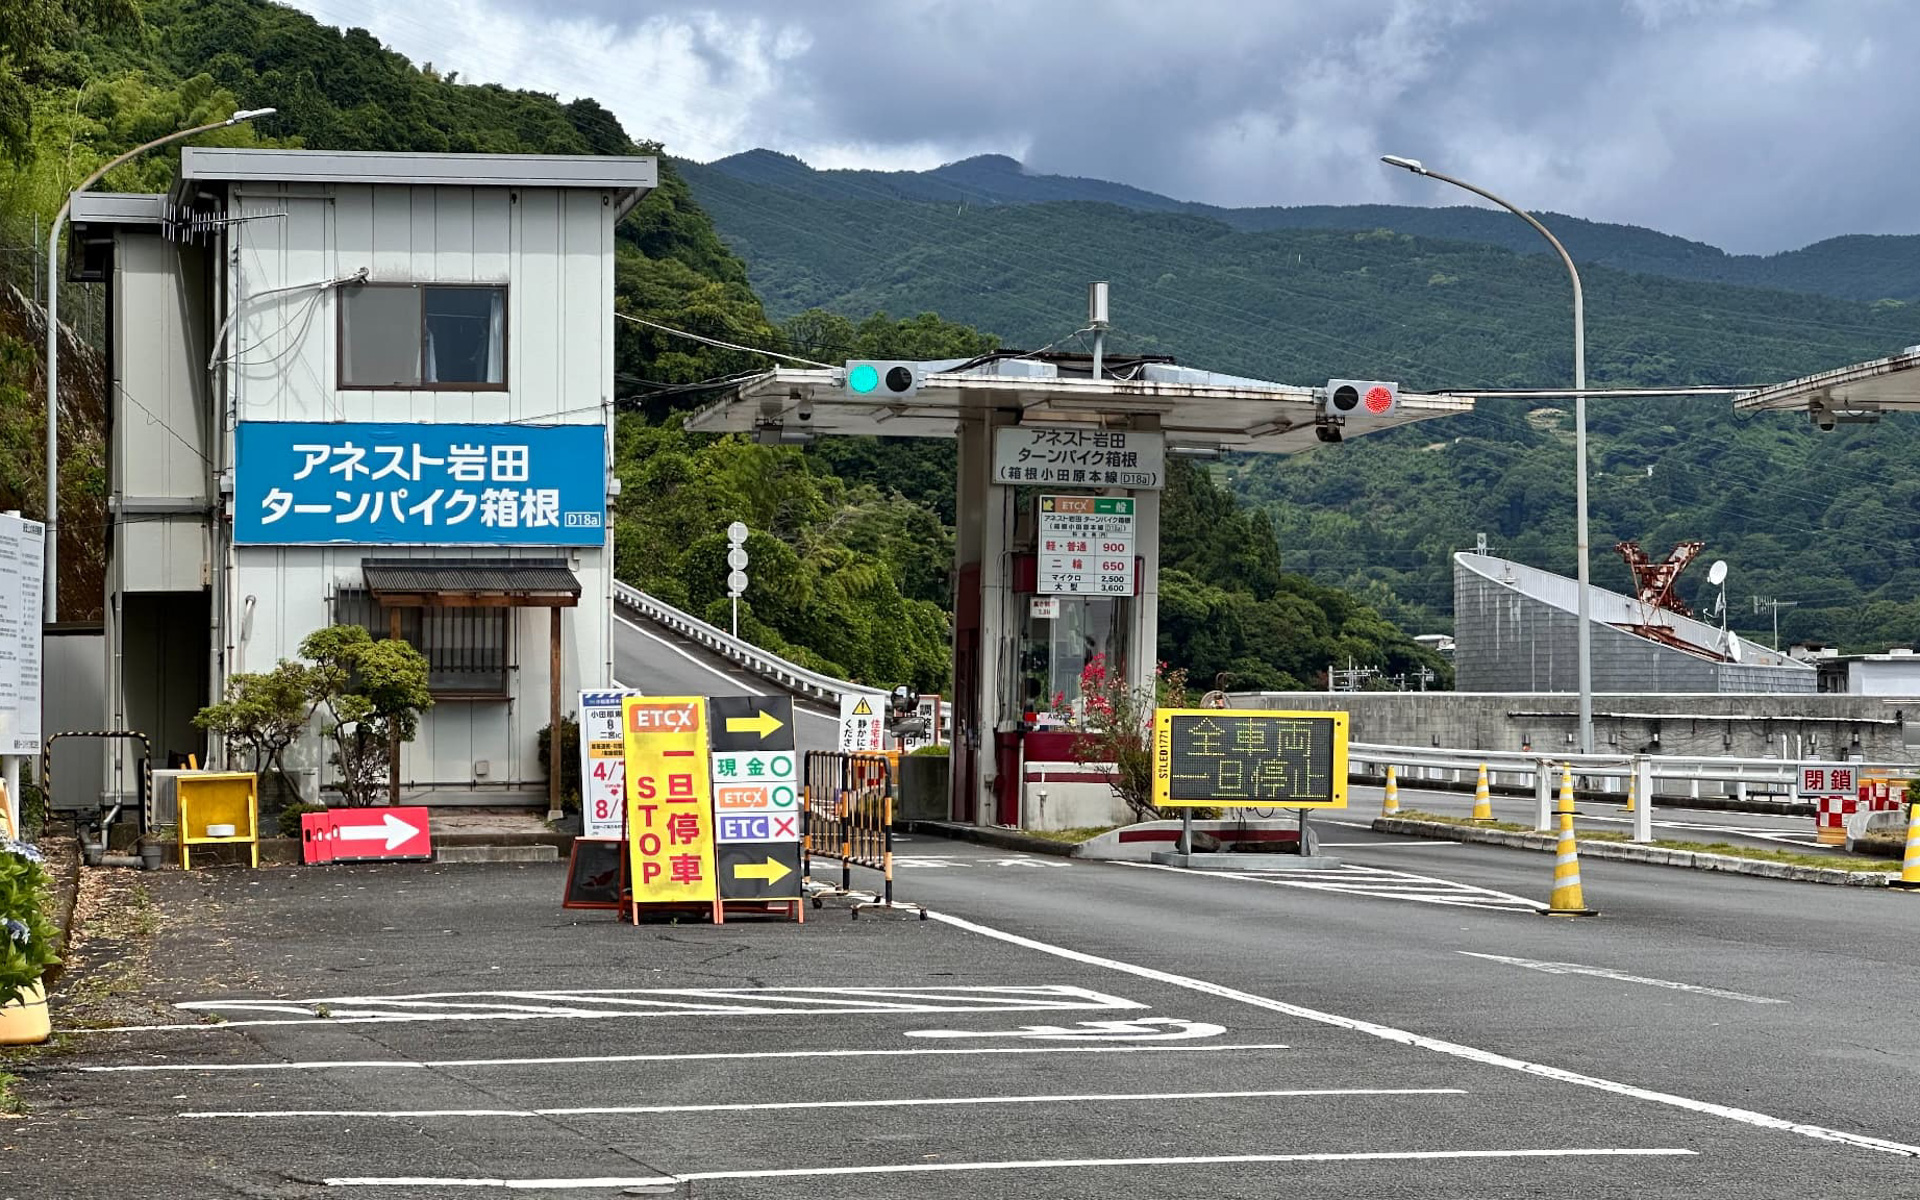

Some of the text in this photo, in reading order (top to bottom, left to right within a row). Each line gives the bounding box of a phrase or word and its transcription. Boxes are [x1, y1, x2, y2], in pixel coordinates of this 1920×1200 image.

[1031, 430, 1126, 449] アネスト岩田
[293, 442, 529, 482] アネスト岩田
[1018, 448, 1137, 468] ターンパイク箱根
[261, 488, 600, 528] ターンパイク箱根 D18a
[1062, 500, 1089, 513] ETCX
[1103, 543, 1125, 552] 900
[1102, 562, 1125, 571] 650
[637, 704, 692, 733] ETCX
[717, 757, 766, 777] 現金
[1173, 758, 1327, 797] 一旦停止
[1804, 769, 1852, 791] 閉鎖
[723, 788, 765, 807] ETCX
[663, 750, 703, 886] 一旦停車
[725, 819, 765, 837] ETC
[637, 775, 662, 885] STOP
